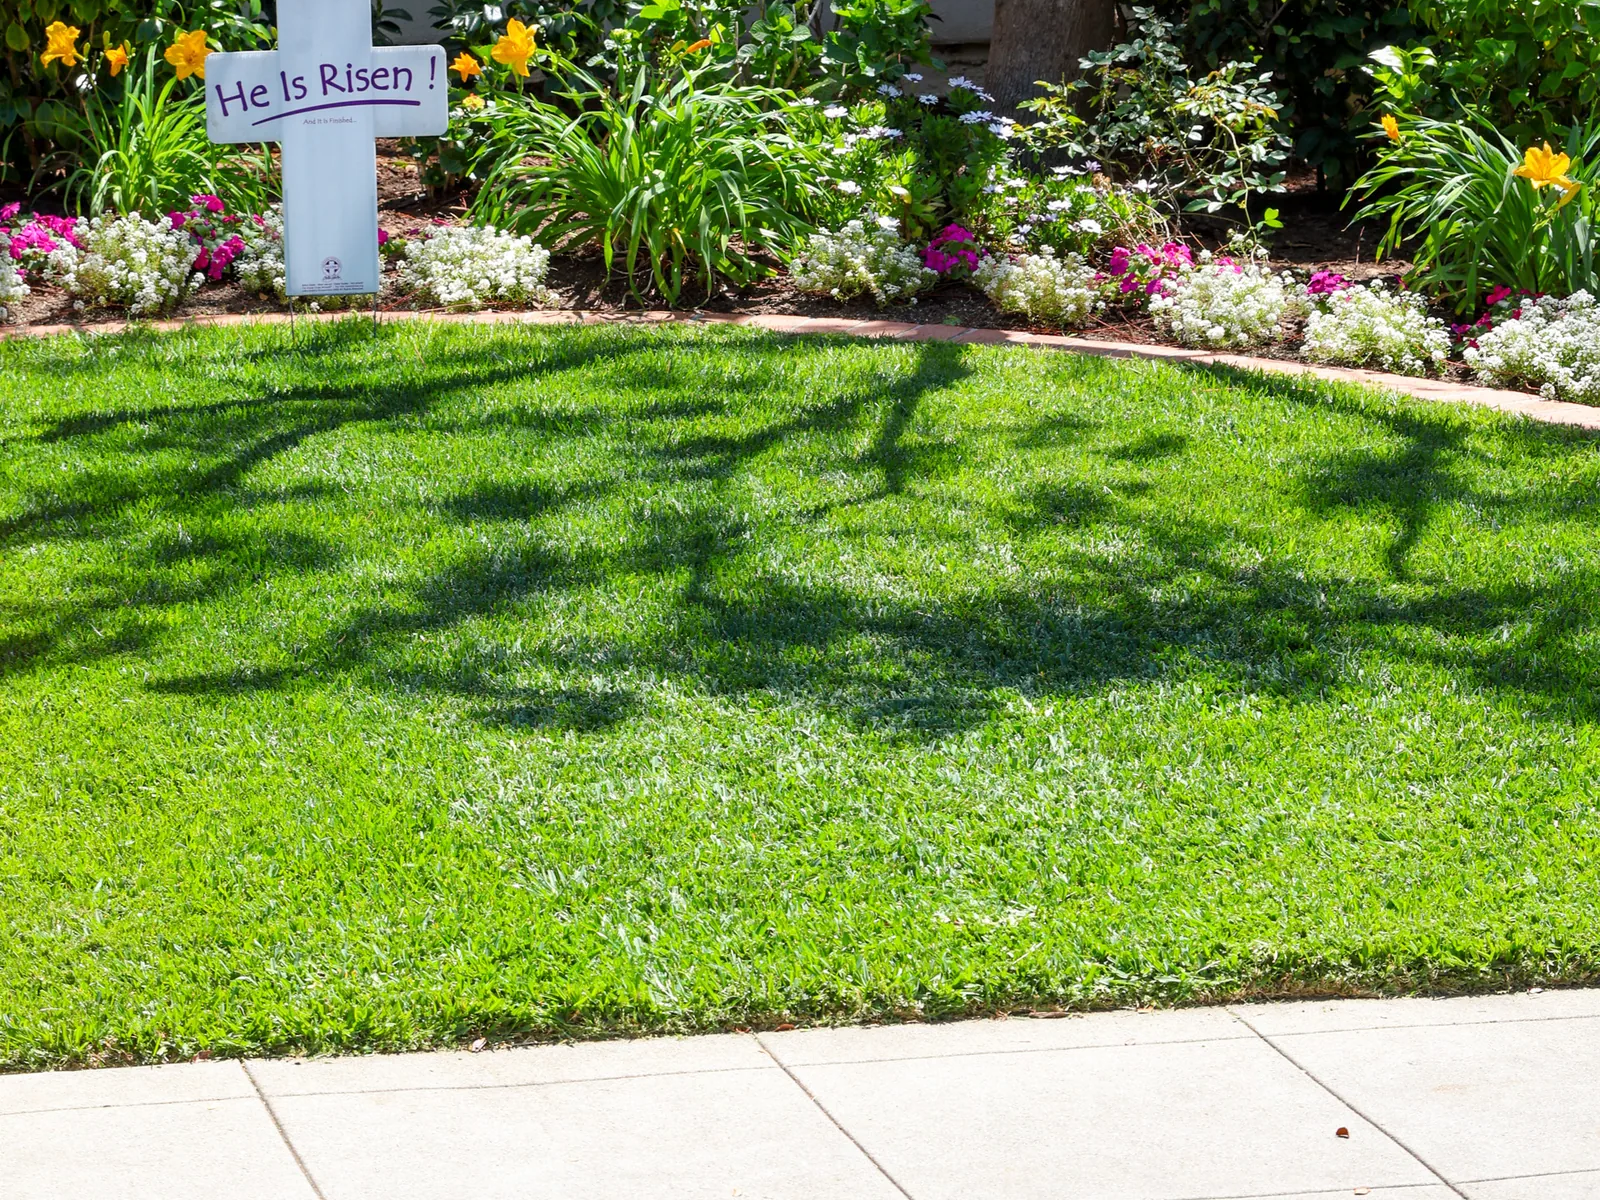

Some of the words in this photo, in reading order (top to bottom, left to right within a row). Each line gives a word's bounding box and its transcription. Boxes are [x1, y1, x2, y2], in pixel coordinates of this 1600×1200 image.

[215, 80, 270, 117] He
[280, 70, 308, 102] Is
[319, 63, 413, 96] Risen
